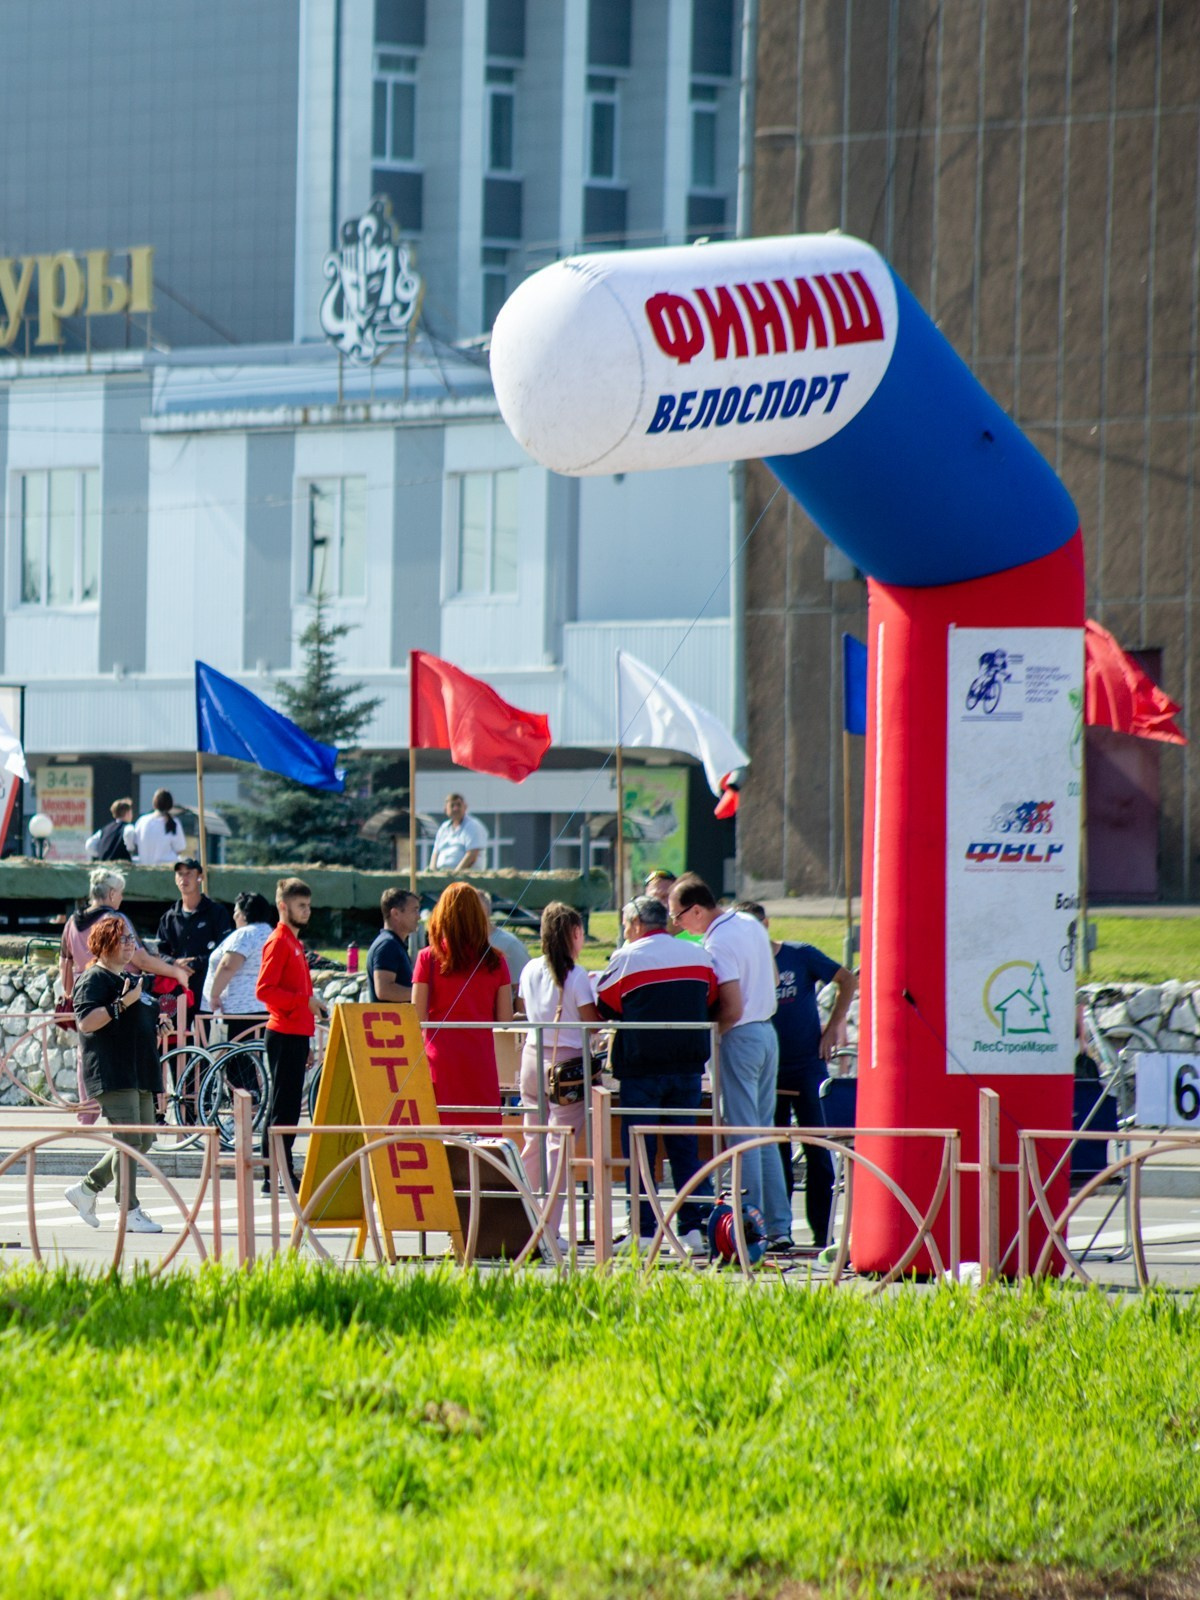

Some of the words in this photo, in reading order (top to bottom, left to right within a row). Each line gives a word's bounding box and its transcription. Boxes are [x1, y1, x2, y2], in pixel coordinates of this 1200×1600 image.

[645, 271, 885, 365] ФИНИШ
[646, 373, 849, 434] ВЕЛОСПОРТ
[973, 1040, 1059, 1055] ЛесСтройМаркет
[362, 1012, 434, 1222] СТАРТ
